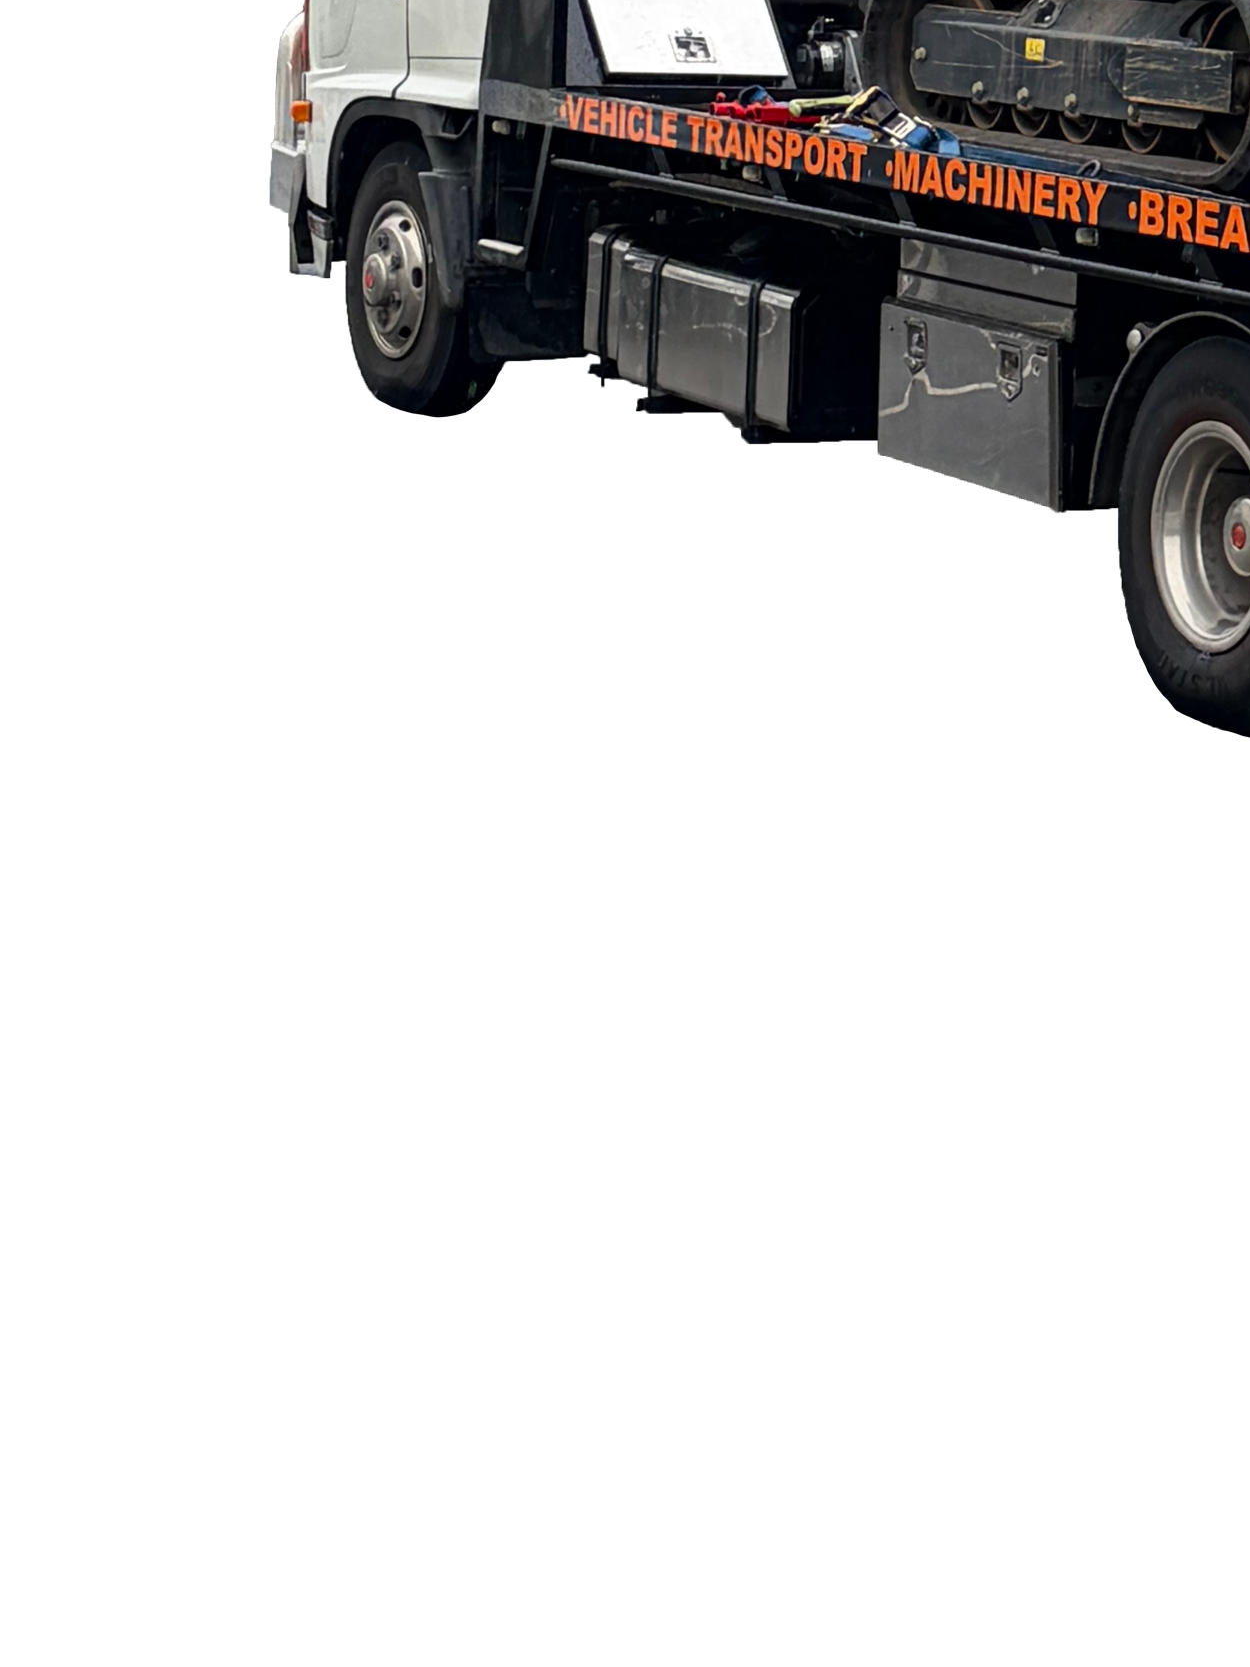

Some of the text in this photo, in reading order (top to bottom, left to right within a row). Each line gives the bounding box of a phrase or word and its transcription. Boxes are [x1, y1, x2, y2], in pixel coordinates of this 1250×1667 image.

[566, 95, 678, 150] VEHICLE
[687, 116, 867, 184] TRANSPORT
[893, 151, 1108, 226] MACHINERY
